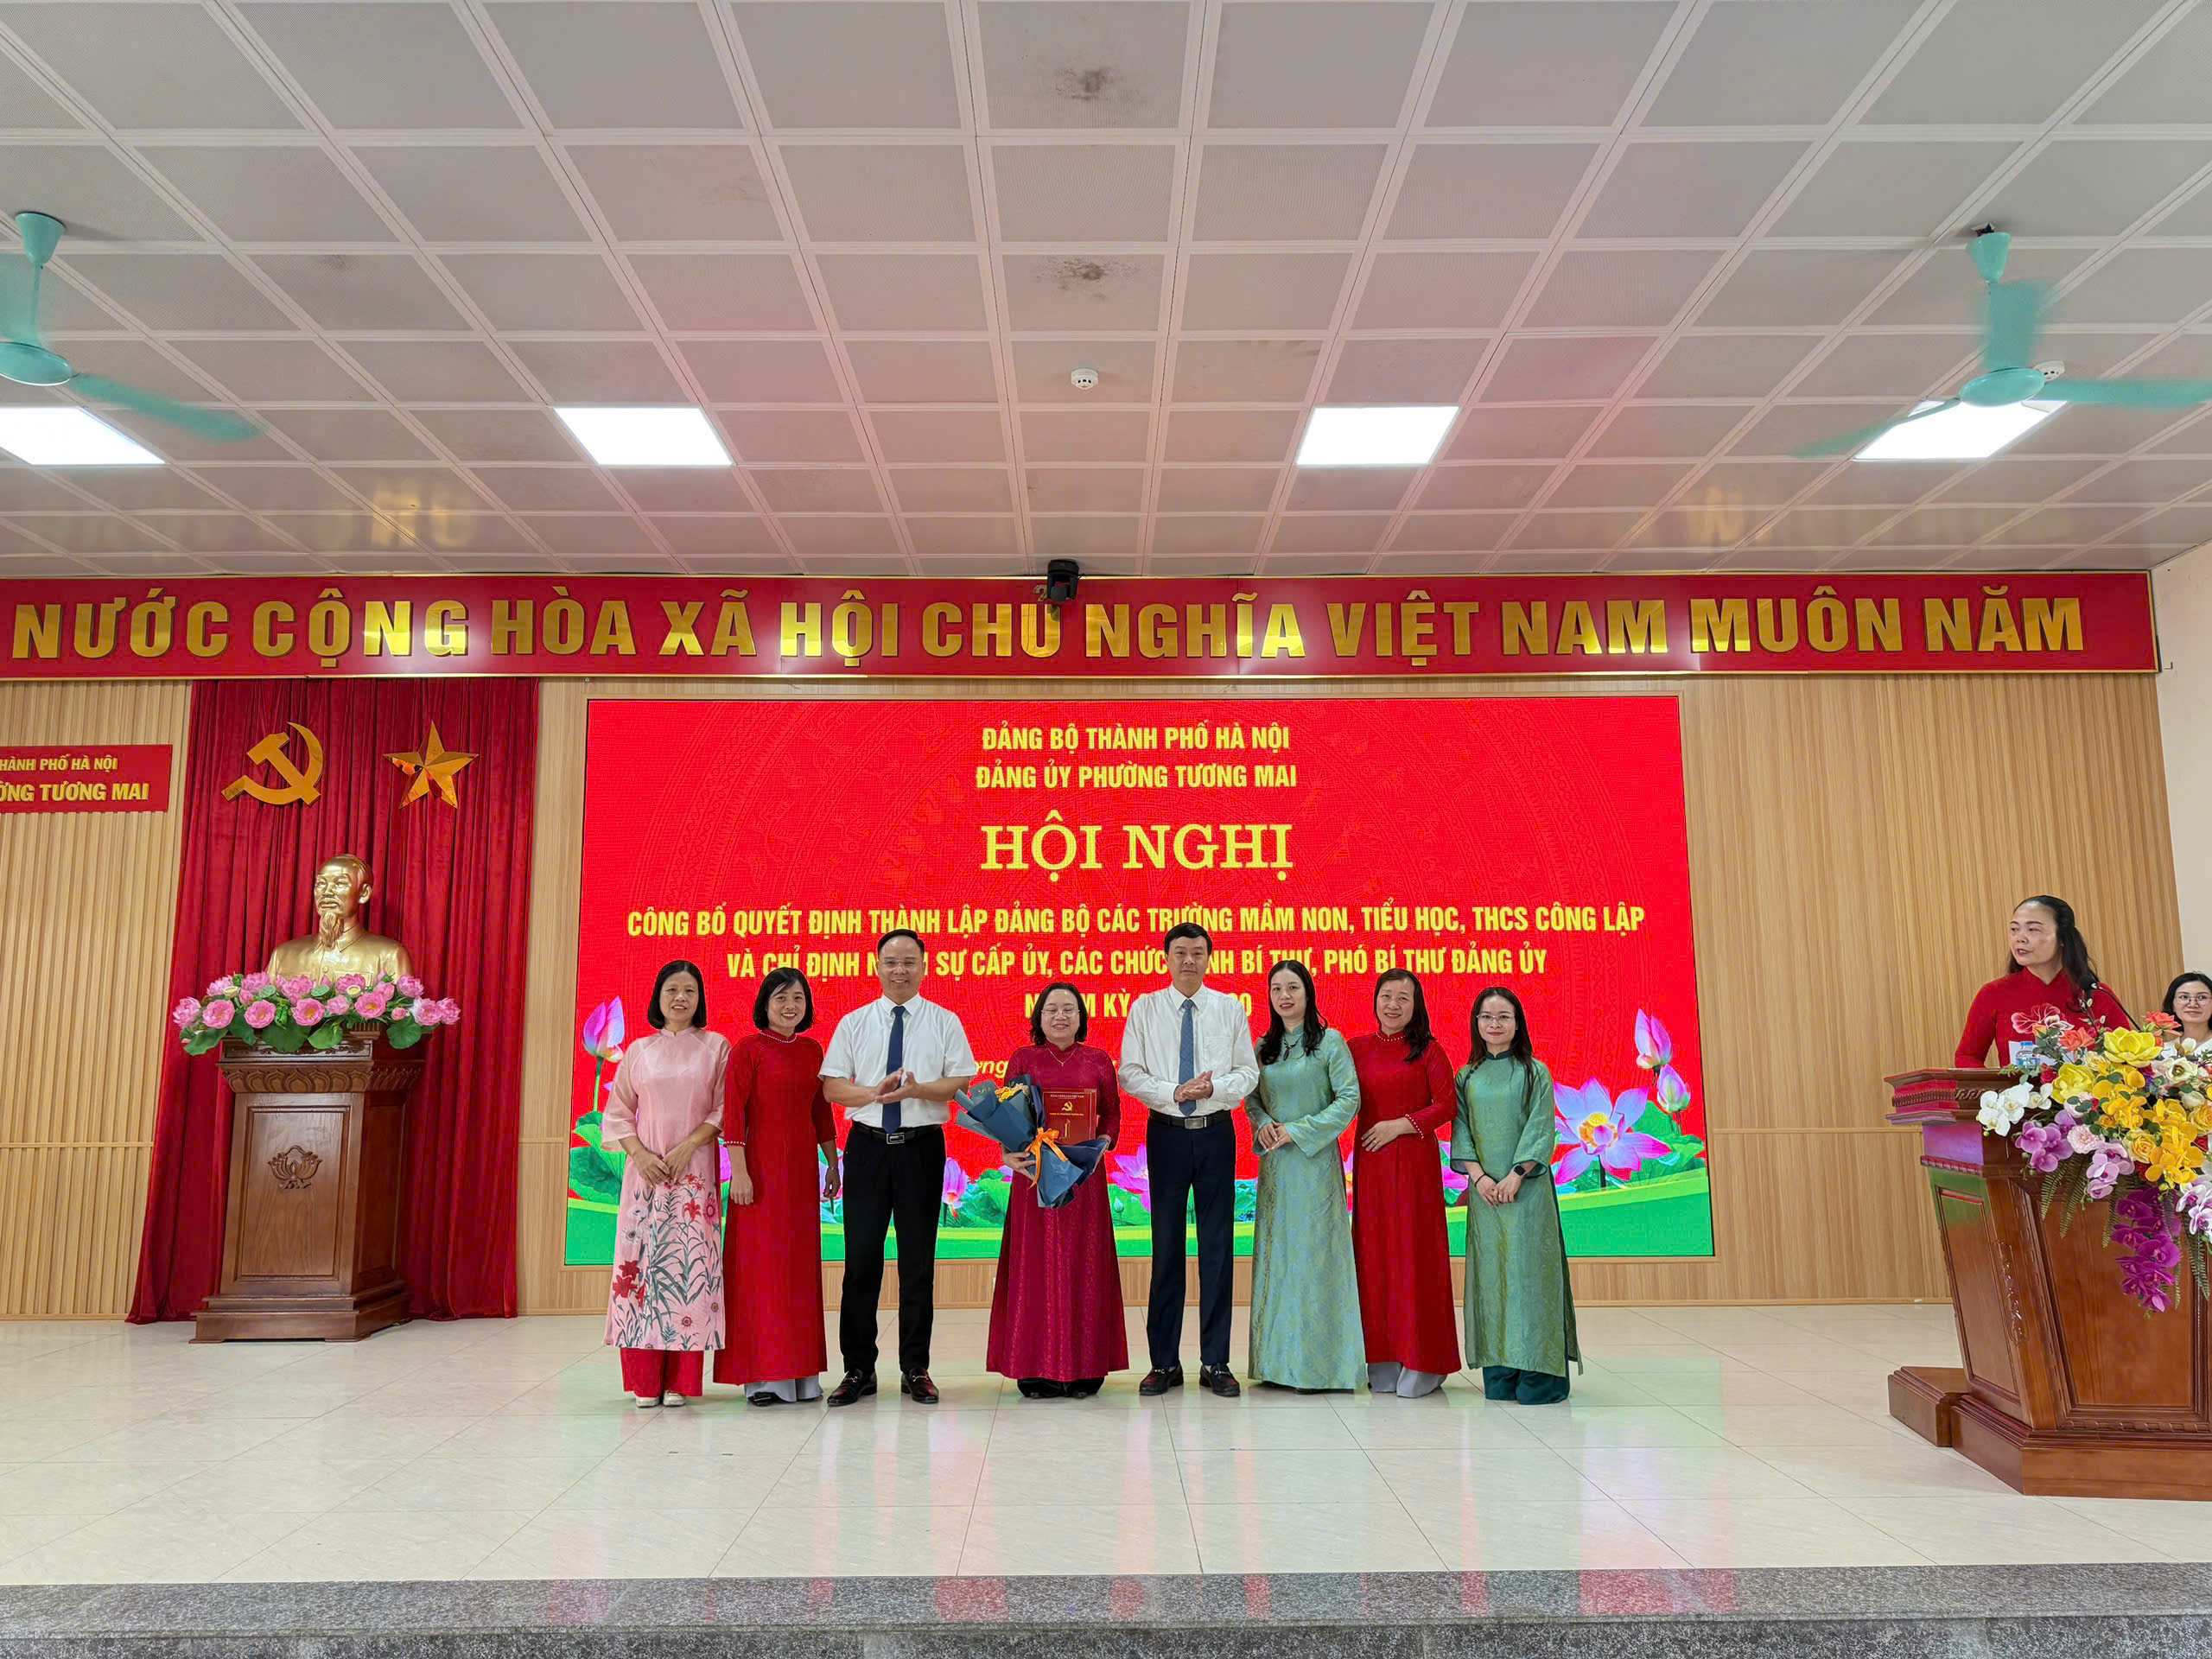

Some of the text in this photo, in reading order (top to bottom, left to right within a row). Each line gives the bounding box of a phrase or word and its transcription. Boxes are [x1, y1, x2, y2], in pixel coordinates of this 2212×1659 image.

[12, 584, 2084, 667] NƯỚC CỘNG HÒA XÃ HỘI CHỦ NGHĨA VIỆT NAM MUÔN NĂM
[982, 719, 1290, 753] ĐẢNG BỘ THÀNH PHỐ HÀ NỘI
[0, 753, 118, 773] HÀNH PHỐ HÀ NỘI
[976, 758, 1297, 788] ĐẢNG ỦY PHƯỜNG TƯƠNG MAI
[0, 779, 149, 802] ỜNG TƯƠNG MAI
[981, 809, 1294, 882] HỘI NGHỊ
[628, 897, 1645, 940] CÔNG BỐ QUYẾT ĐỊNH THÀNH LẬP ĐẢNG BỘ CÁC TRƯỜNG MẦM NON, TIỂU HỌC, THCS CÔNG LẬP
[728, 948, 756, 978] VÀ
[763, 944, 801, 975] CHỈ
[806, 952, 860, 982] ĐỊNH
[936, 949, 968, 981] SỰ
[972, 943, 1015, 976] CẤP
[1022, 944, 1053, 978] ỦY,
[1060, 946, 1103, 976] CÁC
[1110, 944, 1168, 975] CHỨC
[1205, 950, 1235, 975] NH
[1242, 944, 1263, 975] BÍ
[1324, 944, 1368, 974] PHÓ
[1375, 944, 1396, 974] BÍ
[1402, 947, 1446, 974] THƯ
[1452, 941, 1513, 975] ĐẢNG
[1518, 941, 1548, 975] ỦY
[1103, 988, 1131, 1017] KỲ
